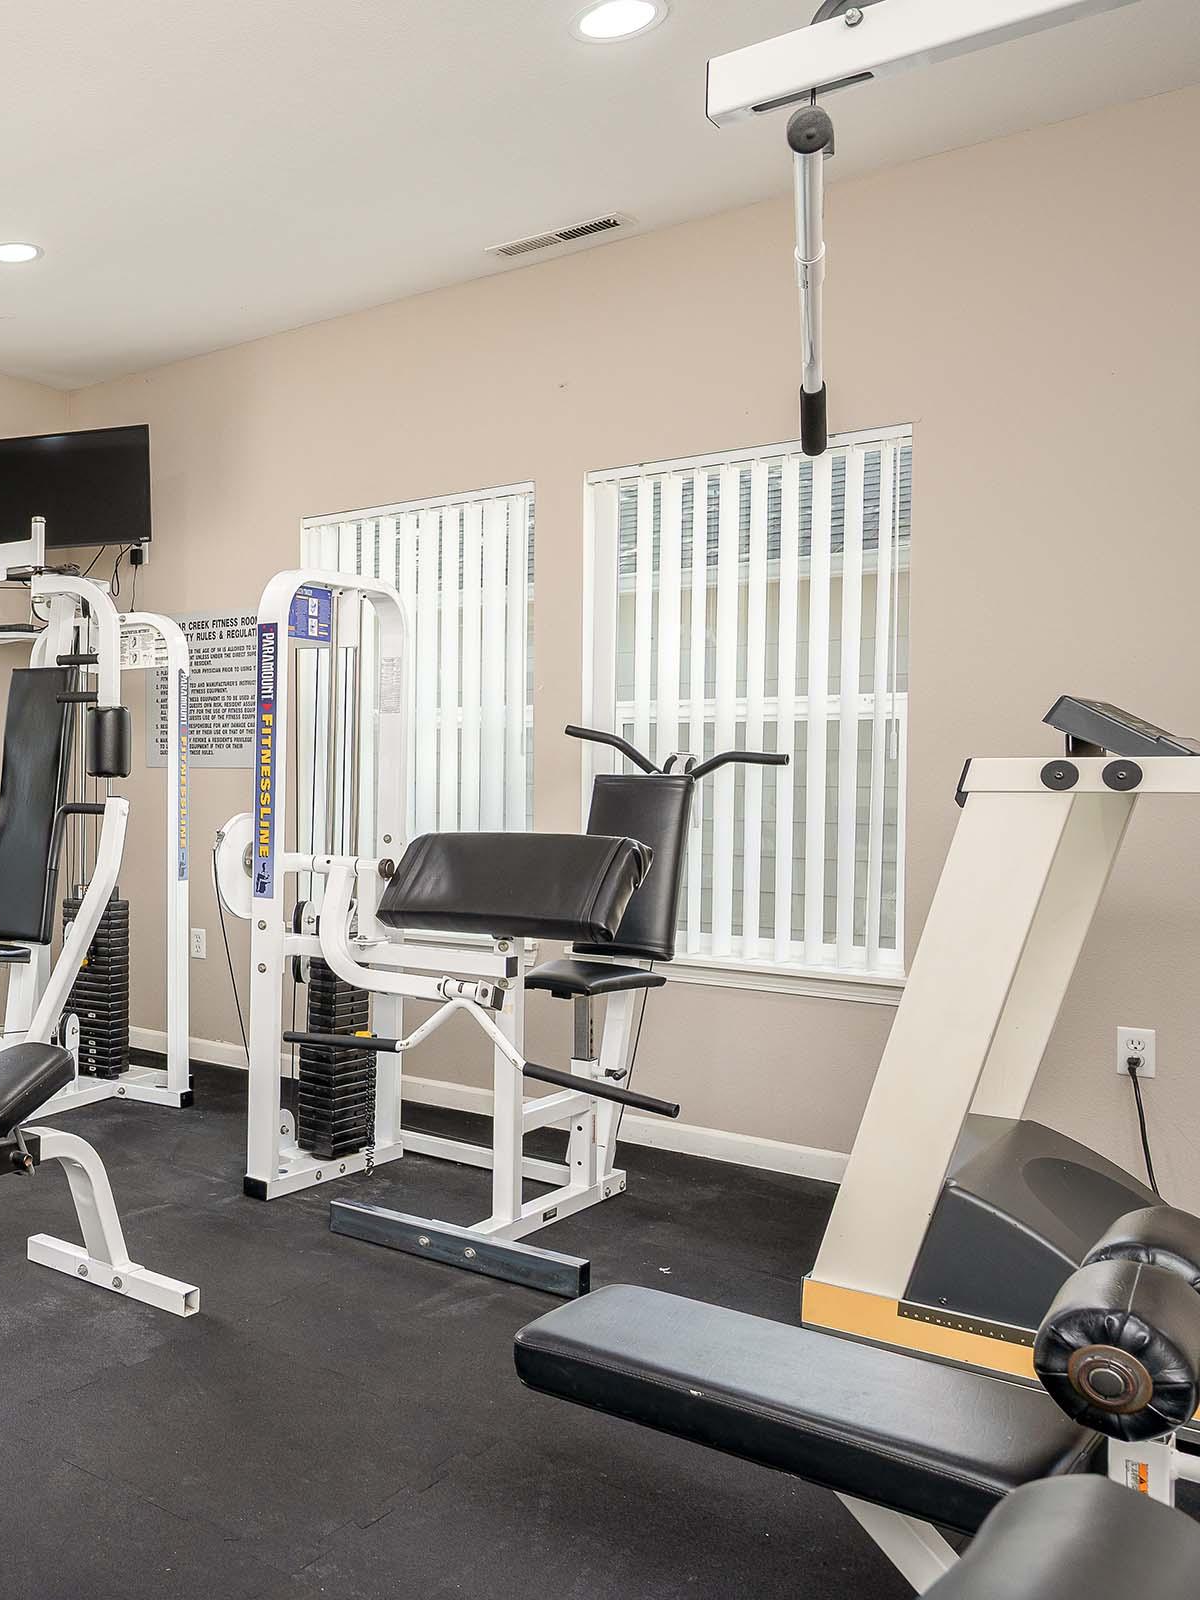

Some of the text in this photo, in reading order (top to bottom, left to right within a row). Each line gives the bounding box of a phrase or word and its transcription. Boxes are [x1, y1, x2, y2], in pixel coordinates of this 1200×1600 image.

[188, 620, 210, 630] CREEK
[212, 618, 238, 628] FITNESS
[196, 631, 216, 641] RULES
[219, 630, 223, 640] &
[261, 632, 275, 700] PARAMOUNT
[258, 714, 273, 858] FITNESSLINE
